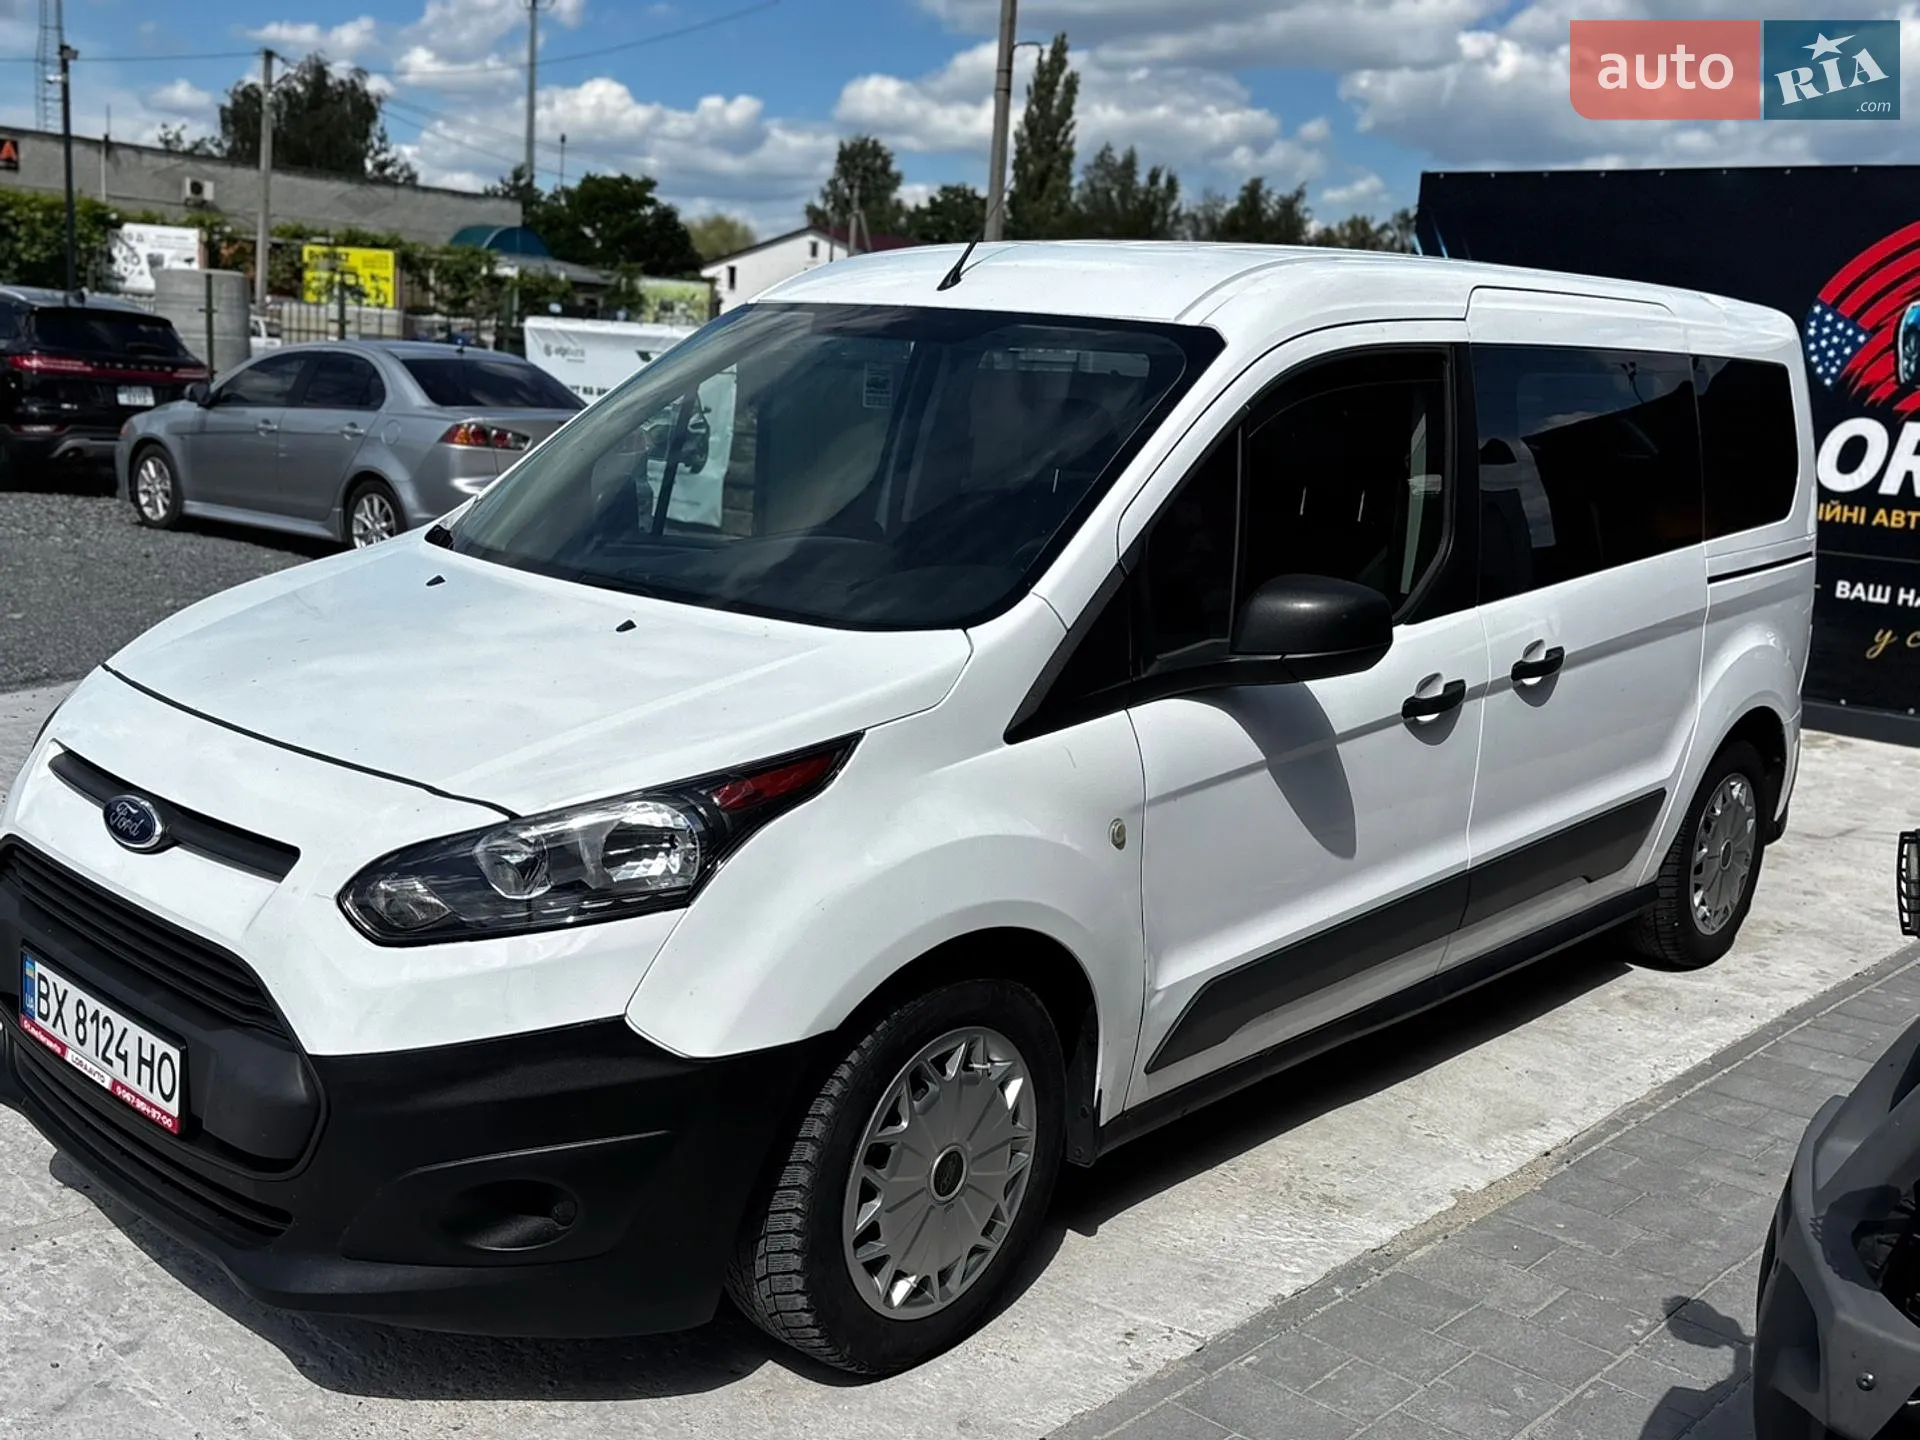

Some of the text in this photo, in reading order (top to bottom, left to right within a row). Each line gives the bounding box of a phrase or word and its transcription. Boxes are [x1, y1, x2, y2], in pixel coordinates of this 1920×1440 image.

[1835, 579, 1891, 604] ВАШ
[110, 801, 145, 837] Ford
[25, 993, 35, 1008] UA
[37, 971, 68, 1037] BX
[75, 998, 129, 1078] 8124
[137, 1035, 176, 1103] HO
